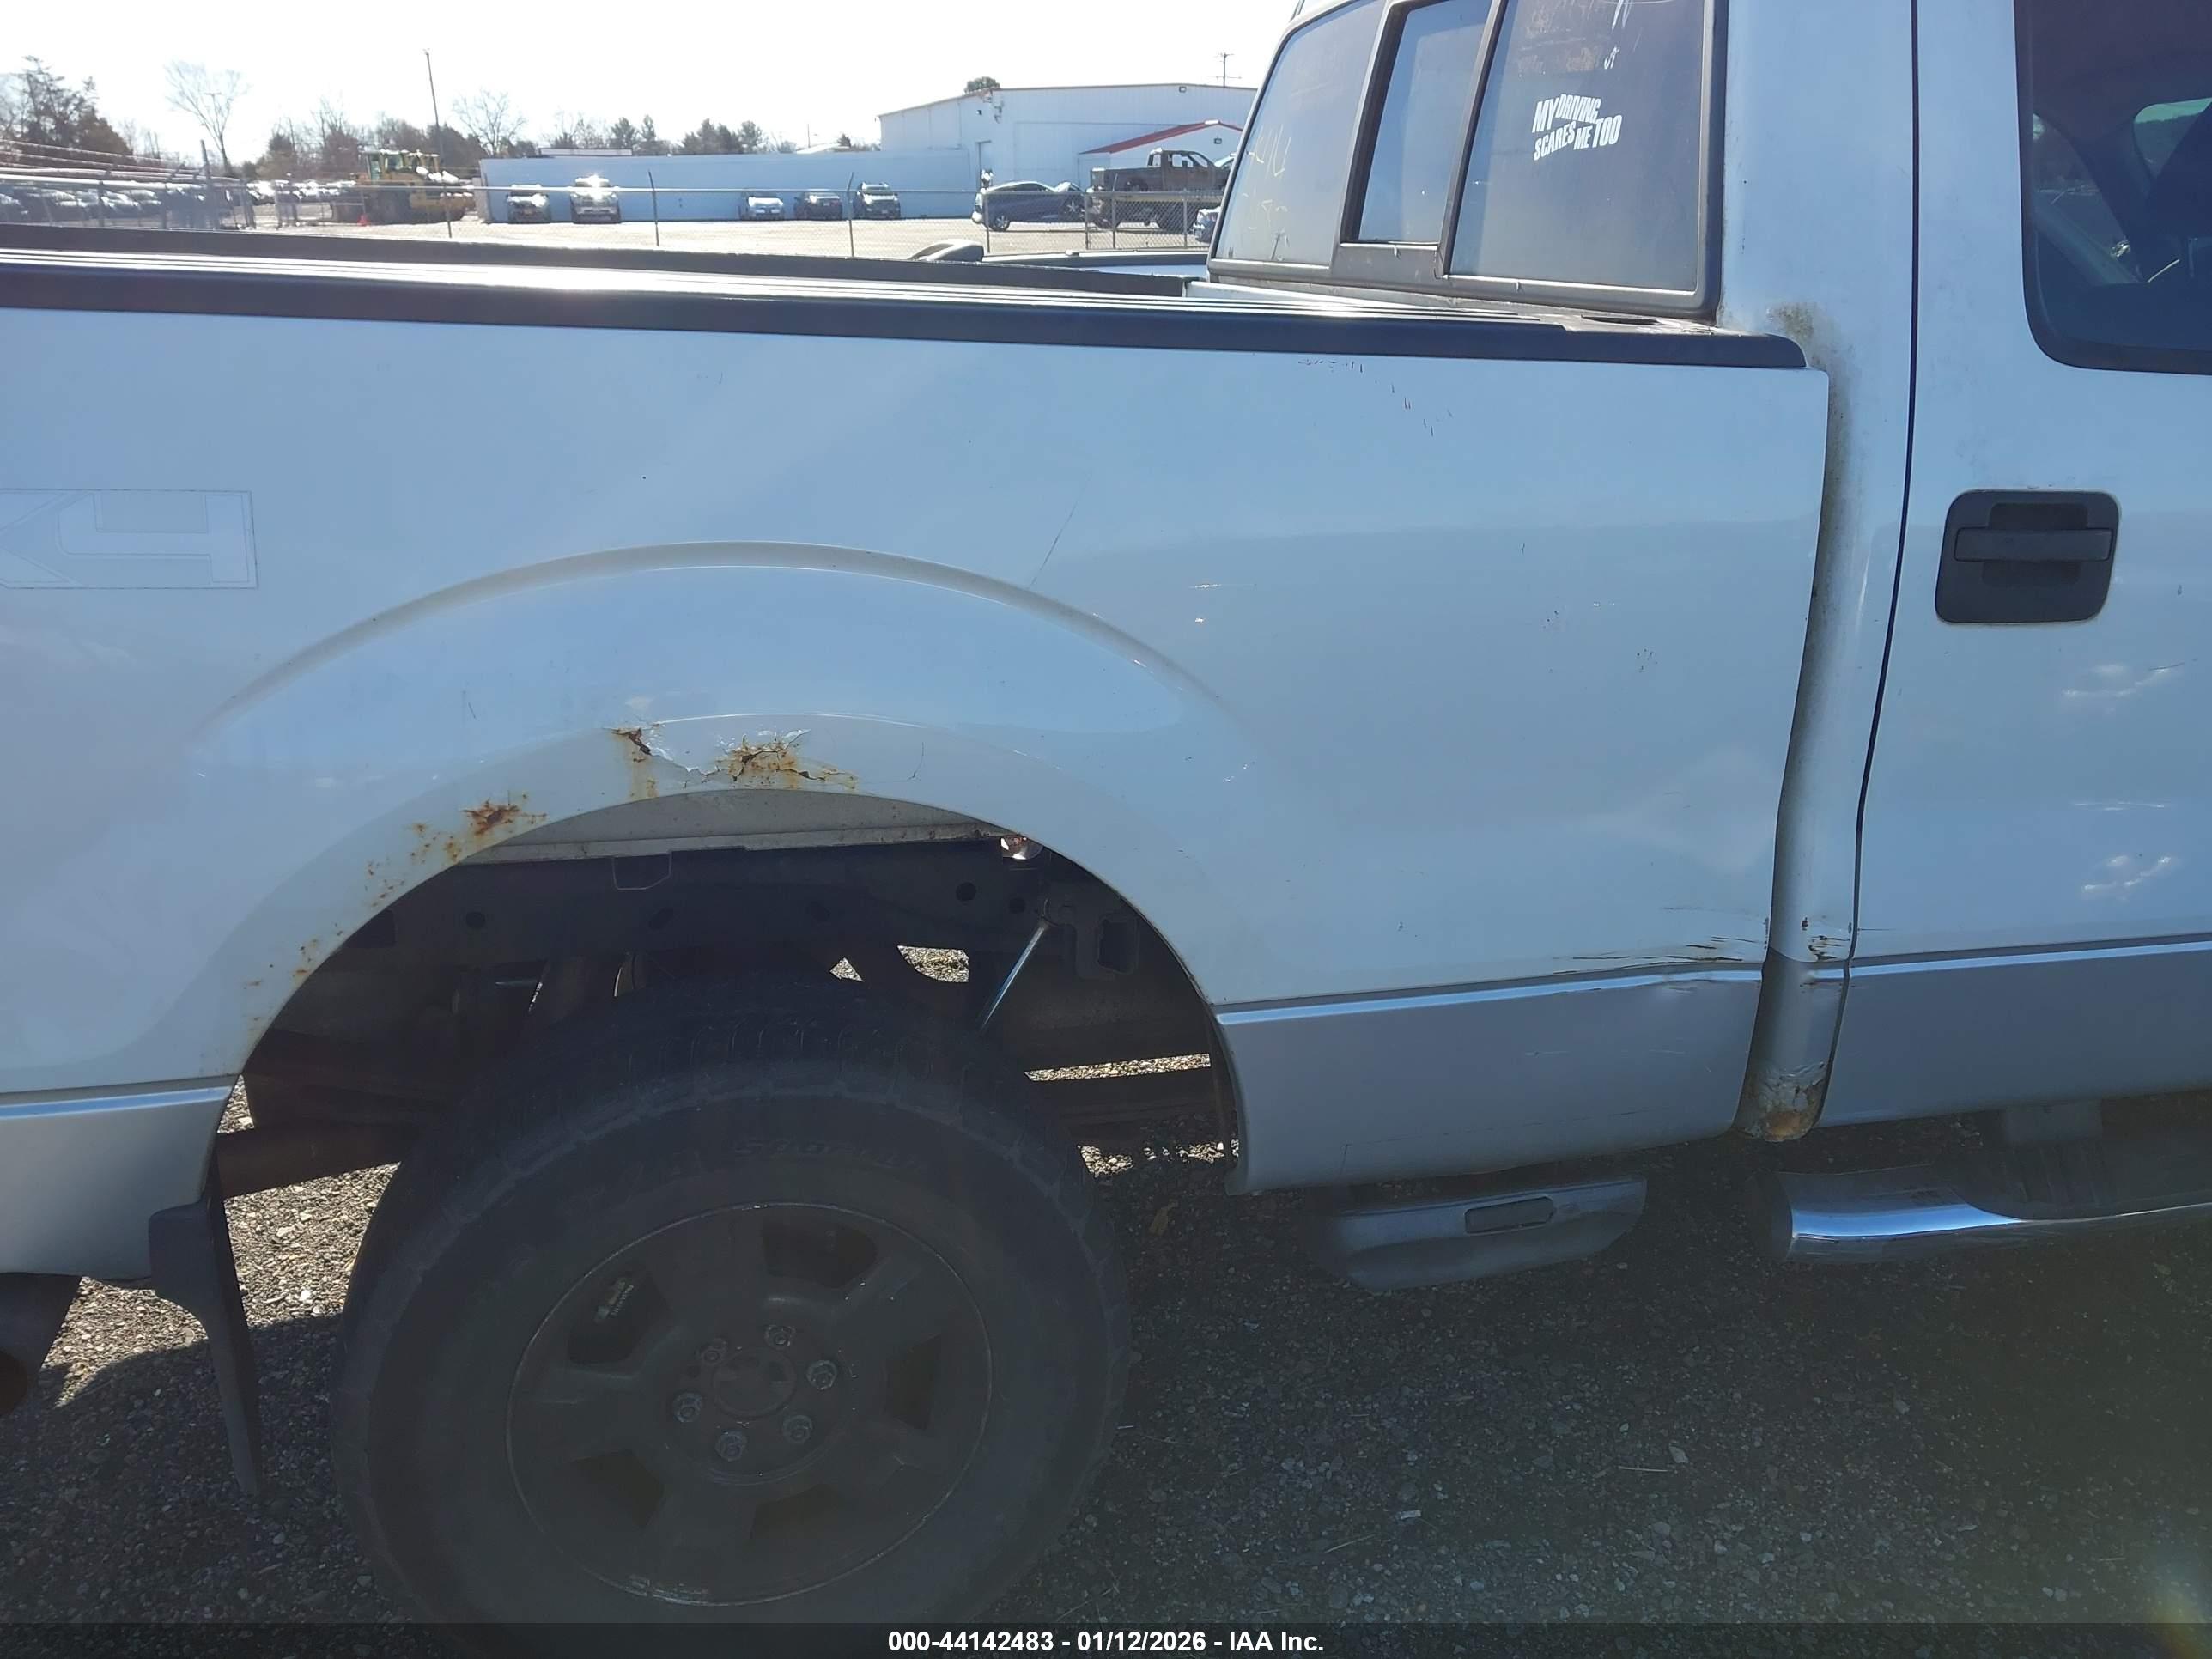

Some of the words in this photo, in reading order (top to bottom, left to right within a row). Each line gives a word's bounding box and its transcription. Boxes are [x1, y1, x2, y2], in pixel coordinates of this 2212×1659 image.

[1532, 98, 1559, 133] MY
[1555, 94, 1601, 124] DRIVING
[1534, 120, 1577, 161] SCARES
[1573, 125, 1593, 150] ME
[1592, 114, 1623, 148] TOO
